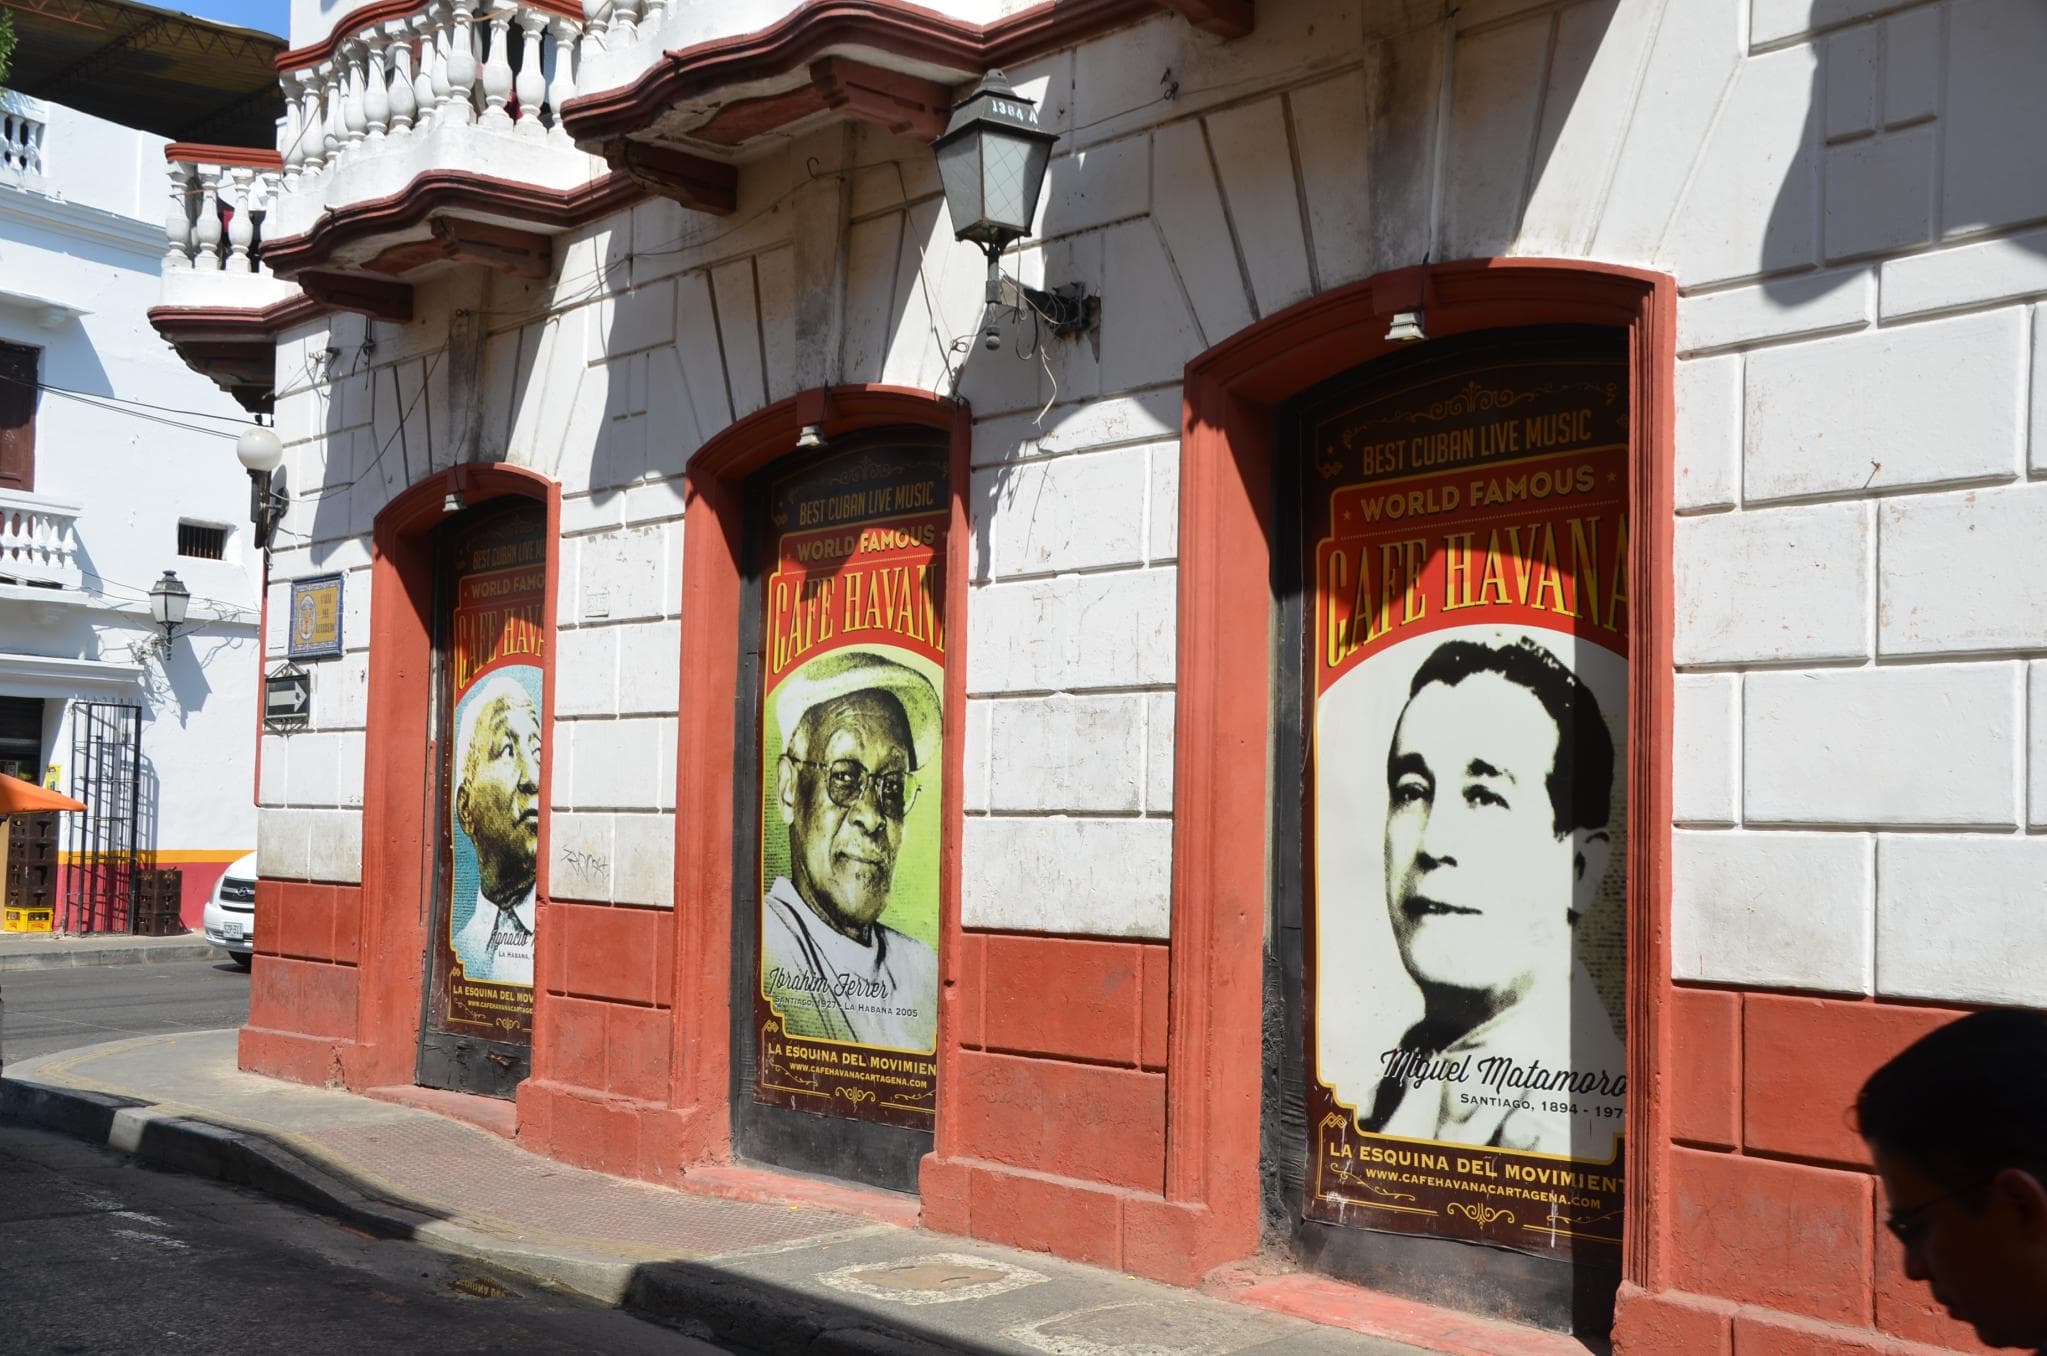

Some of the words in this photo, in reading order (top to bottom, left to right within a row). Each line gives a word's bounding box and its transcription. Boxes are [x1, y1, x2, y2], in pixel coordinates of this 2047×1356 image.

[1362, 440, 1405, 475] BEST
[1411, 427, 1475, 467] CUBAN
[1481, 418, 1519, 456] LIVE
[1526, 408, 1592, 449] MUSIC
[800, 500, 825, 526] BEST
[828, 492, 865, 519] CUBAN
[868, 487, 892, 514] LIVE
[895, 481, 934, 510] MUSIC
[1361, 486, 1460, 521] WORLD
[1471, 465, 1595, 506] FAMOUS
[797, 535, 855, 561] WORLD
[860, 524, 935, 553] FAMOUS
[471, 579, 511, 599] WORLD
[1327, 538, 1426, 668] CAFE
[773, 576, 836, 674] CAFE
[458, 611, 497, 689] CAFE
[453, 984, 463, 995] LA
[465, 986, 498, 999] ESQUINA
[500, 990, 515, 1001] DEL
[769, 967, 829, 995] Ibrahim
[834, 974, 888, 999] Ferrer
[895, 1007, 918, 1018] 2005
[768, 1043, 782, 1056] LA
[785, 1045, 838, 1063] ESQUINA
[842, 1053, 866, 1067] DEL
[1380, 1048, 1472, 1090] Miguel
[789, 1063, 927, 1088] WWW.CAFEHAVANACARTAGENA.COM
[1541, 1101, 1578, 1115] 1894
[1330, 1142, 1352, 1158] LA
[1360, 1146, 1450, 1172] ESQUINA
[1457, 1158, 1498, 1178] DEL
[1365, 1168, 1601, 1209] WWW.CAFEHAVANACARTAGENA.COM
